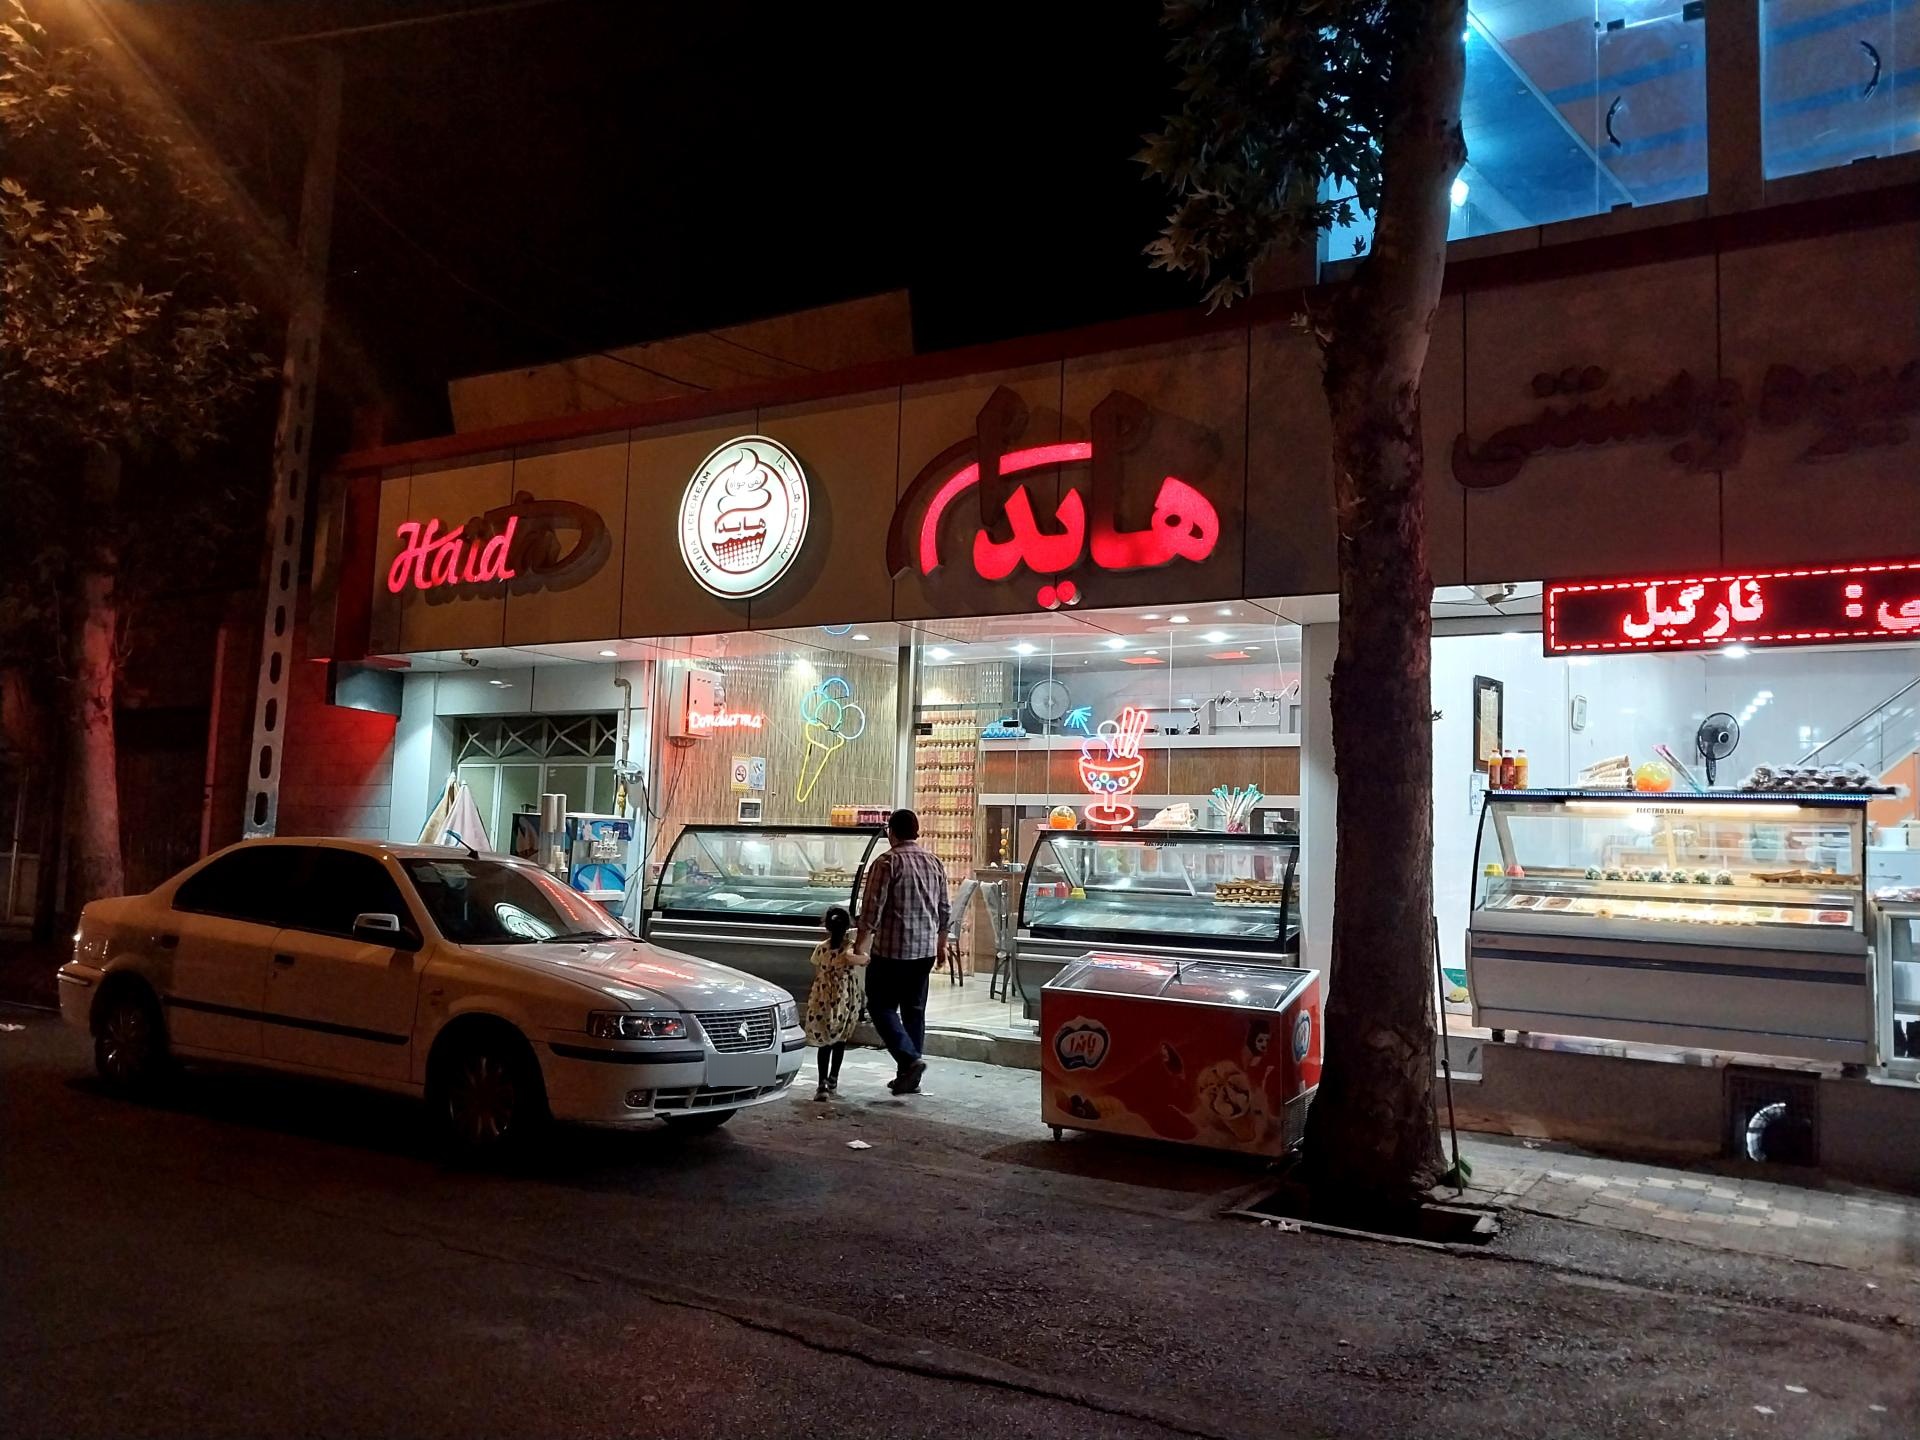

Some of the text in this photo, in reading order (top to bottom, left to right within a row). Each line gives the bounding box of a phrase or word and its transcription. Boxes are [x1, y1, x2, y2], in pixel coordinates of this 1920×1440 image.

[687, 470, 712, 574] HAIDA ICECREAM
[714, 515, 767, 536] هایدا
[1622, 579, 1764, 639] نارگیل
[689, 710, 763, 728] Dondurma
